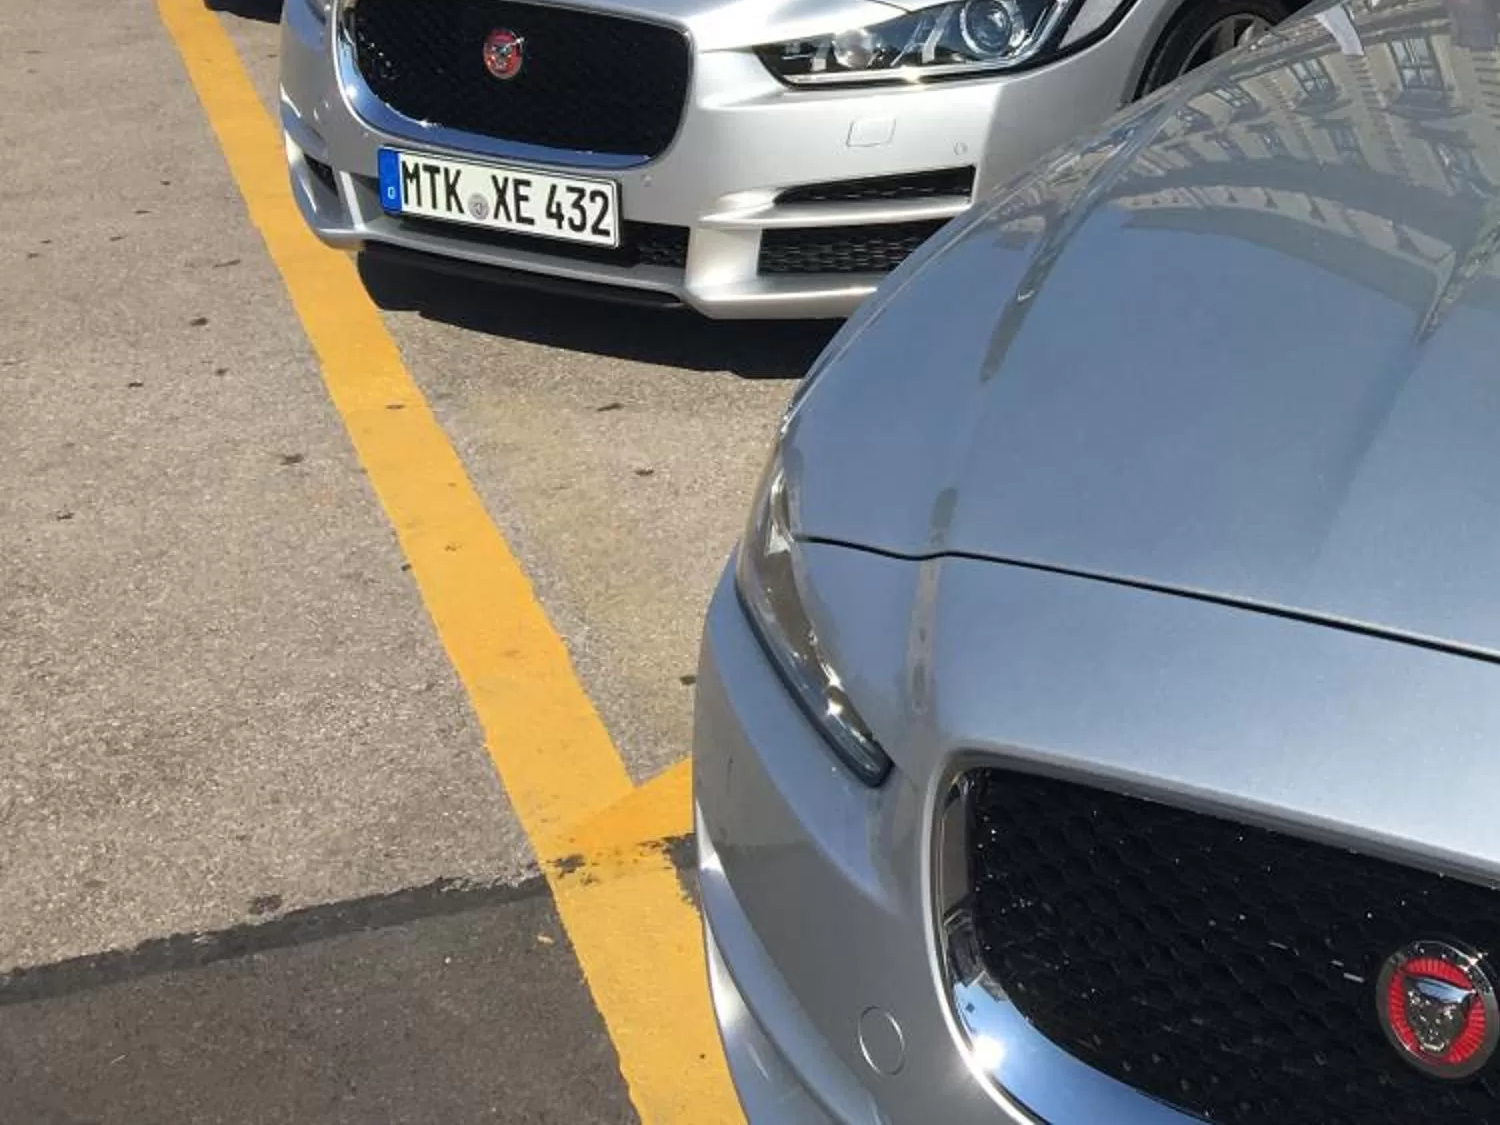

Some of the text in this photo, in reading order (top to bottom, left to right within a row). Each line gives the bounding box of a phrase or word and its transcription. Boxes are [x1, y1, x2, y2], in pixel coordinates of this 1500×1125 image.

[400, 160, 611, 238] MTK XE 432
